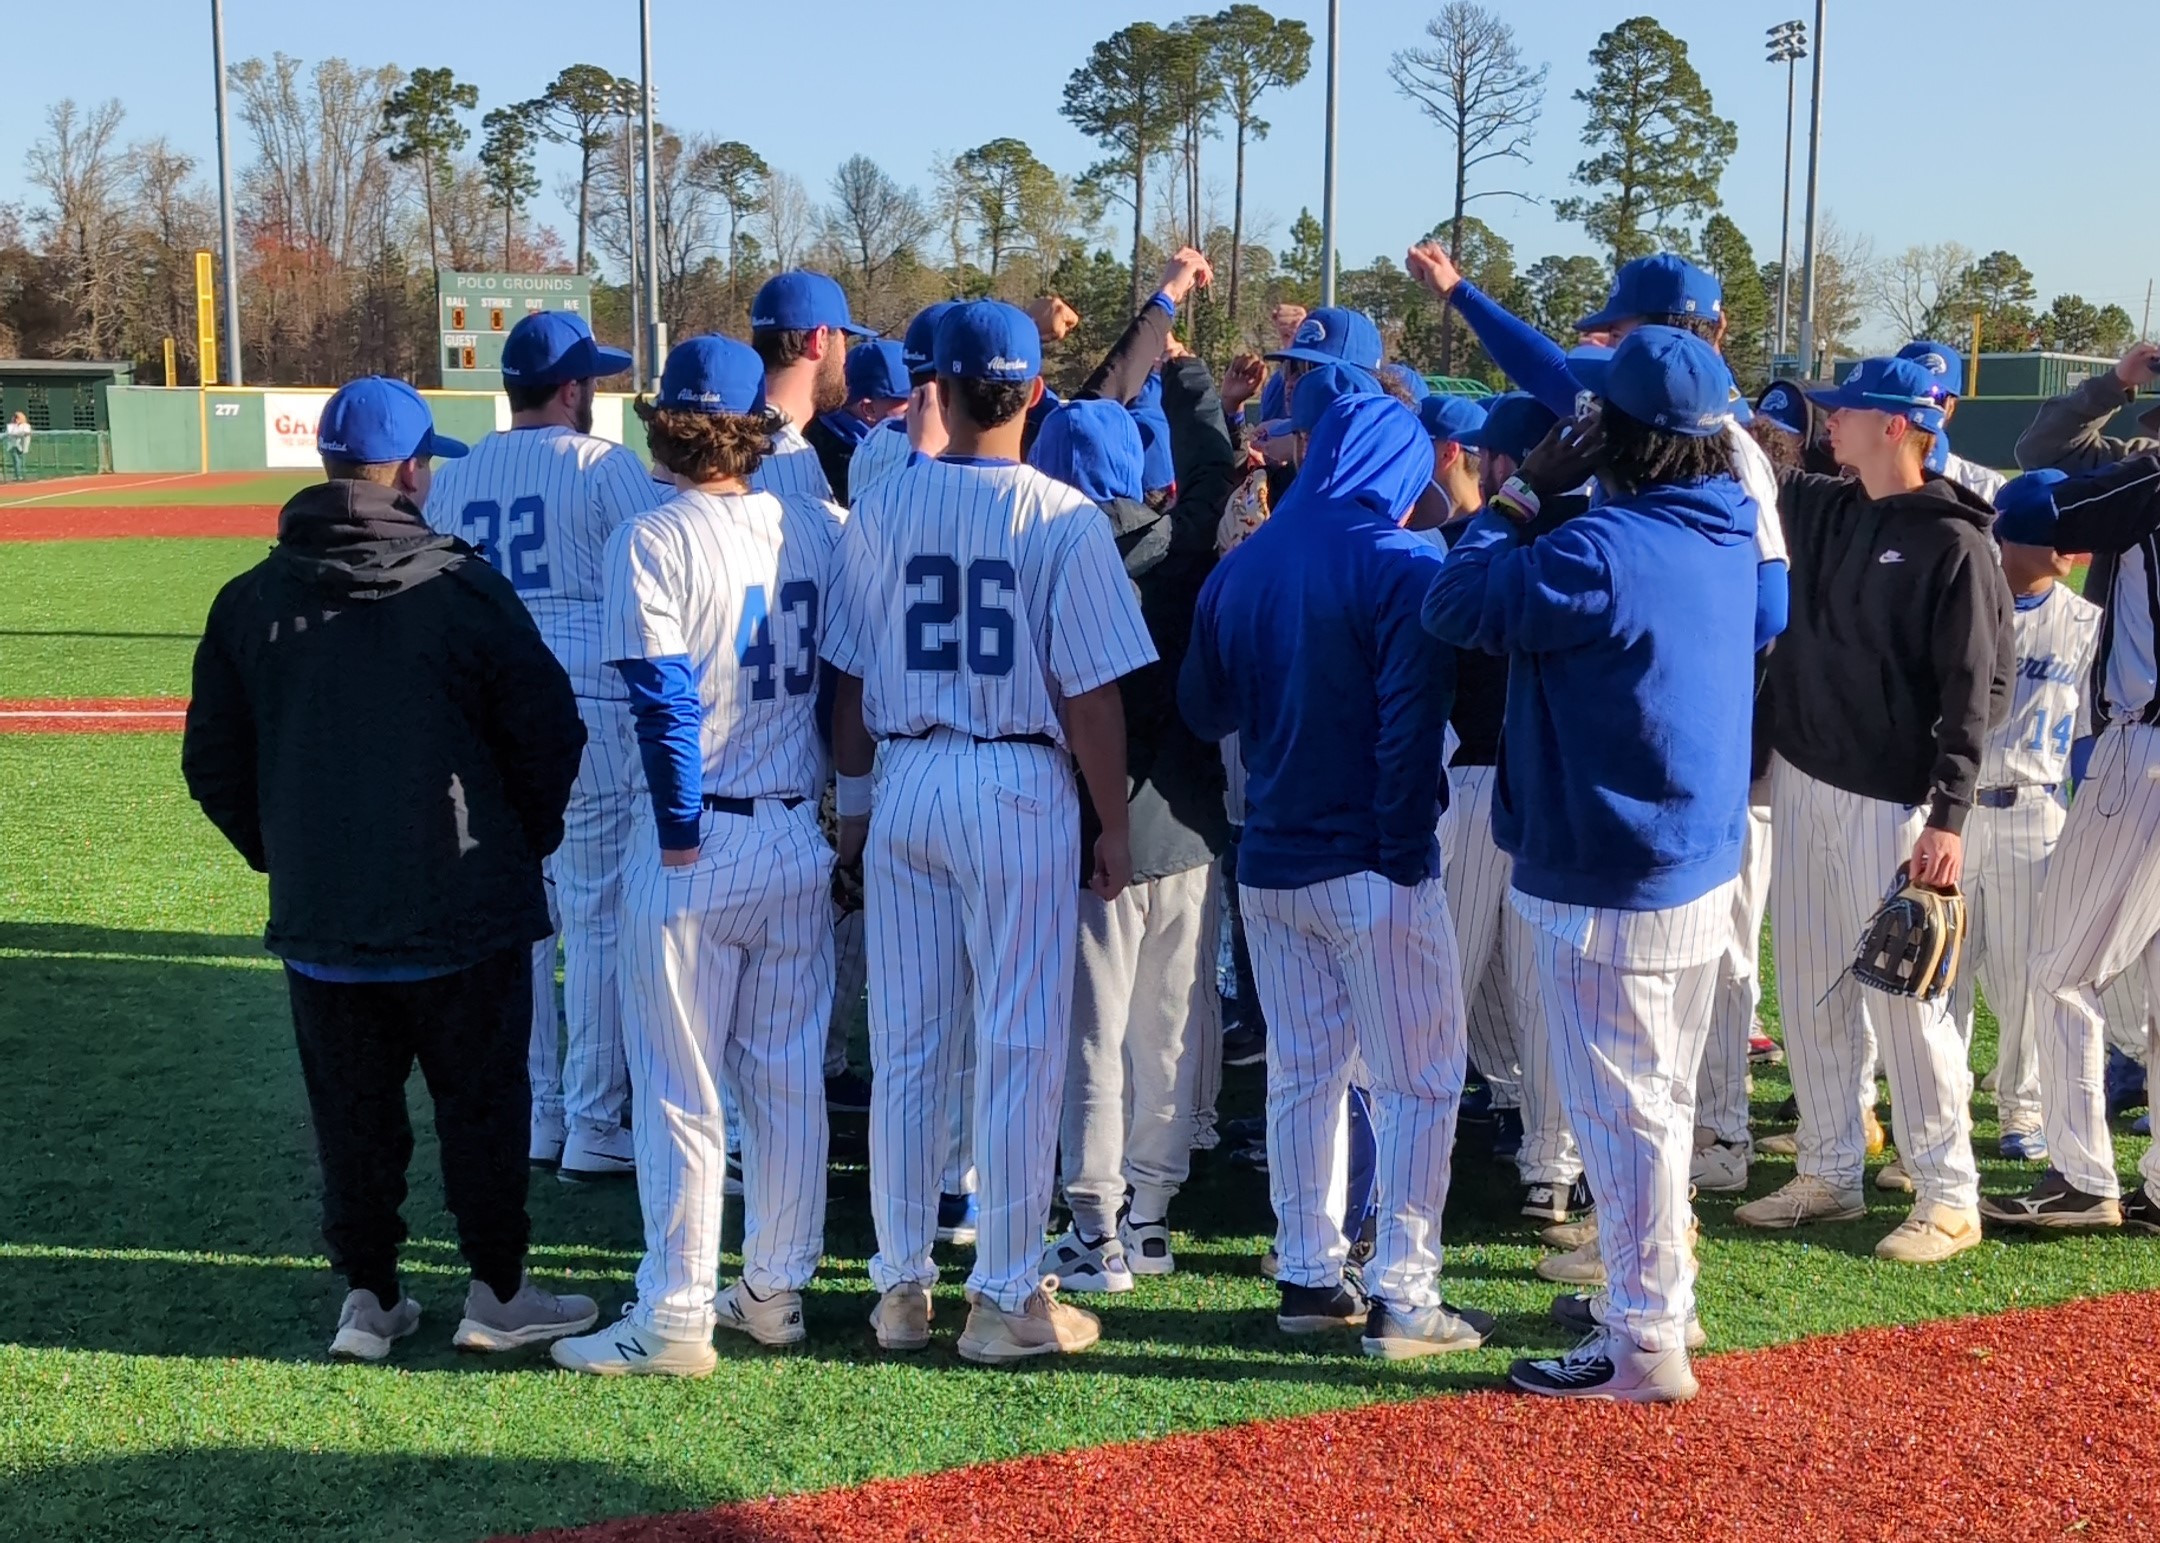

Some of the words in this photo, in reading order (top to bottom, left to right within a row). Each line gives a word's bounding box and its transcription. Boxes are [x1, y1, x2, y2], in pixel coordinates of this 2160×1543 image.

[457, 276, 497, 290] POLO
[502, 277, 573, 291] GROUNDS
[445, 296, 469, 308] BALL
[480, 297, 513, 309] STRIKE
[524, 298, 544, 309] OUT
[444, 334, 478, 347] GUEST
[215, 404, 240, 416] 277
[463, 494, 551, 591] 32
[905, 553, 1015, 677] 26
[734, 579, 818, 701] 43
[2027, 707, 2074, 756] 14
